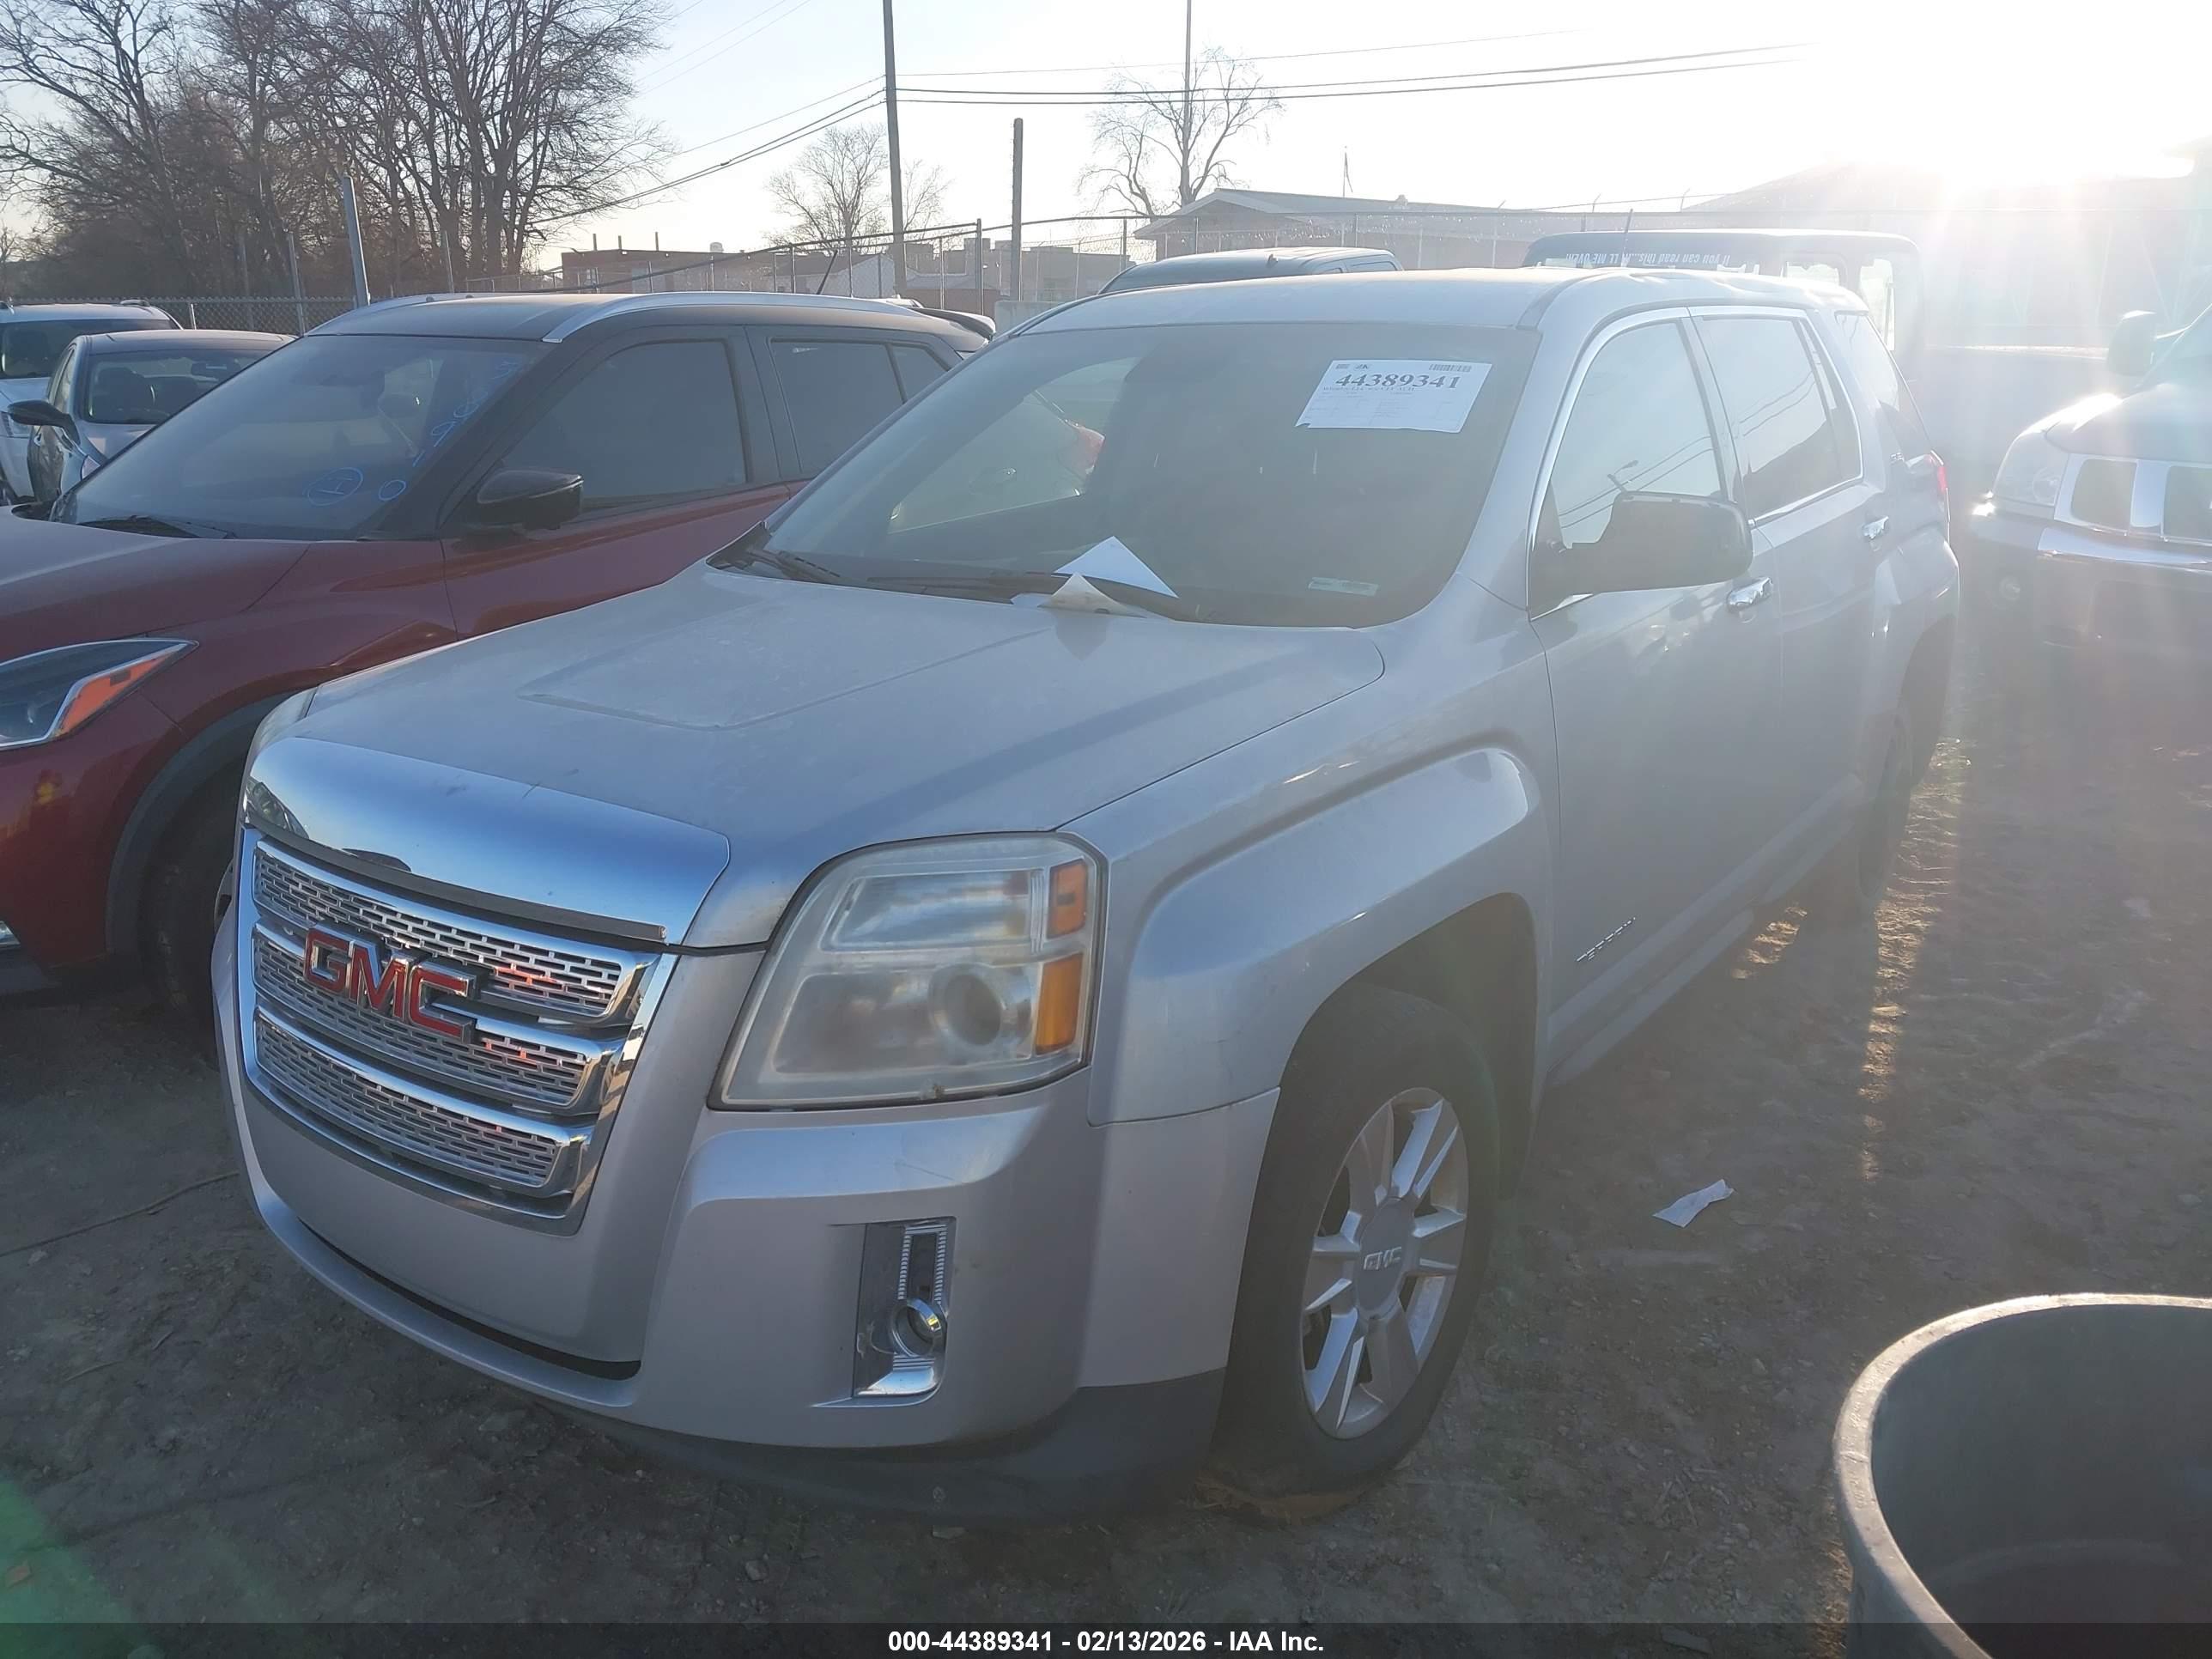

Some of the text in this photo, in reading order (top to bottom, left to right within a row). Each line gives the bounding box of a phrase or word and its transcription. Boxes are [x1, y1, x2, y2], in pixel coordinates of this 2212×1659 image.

[1657, 254, 1680, 264] read
[1682, 254, 1700, 264] can
[1702, 254, 1721, 264] you
[1721, 254, 1731, 266] If
[1335, 373, 1461, 389] 44389341
[304, 926, 474, 1044] GMC
[1363, 1246, 1402, 1270] GMC
